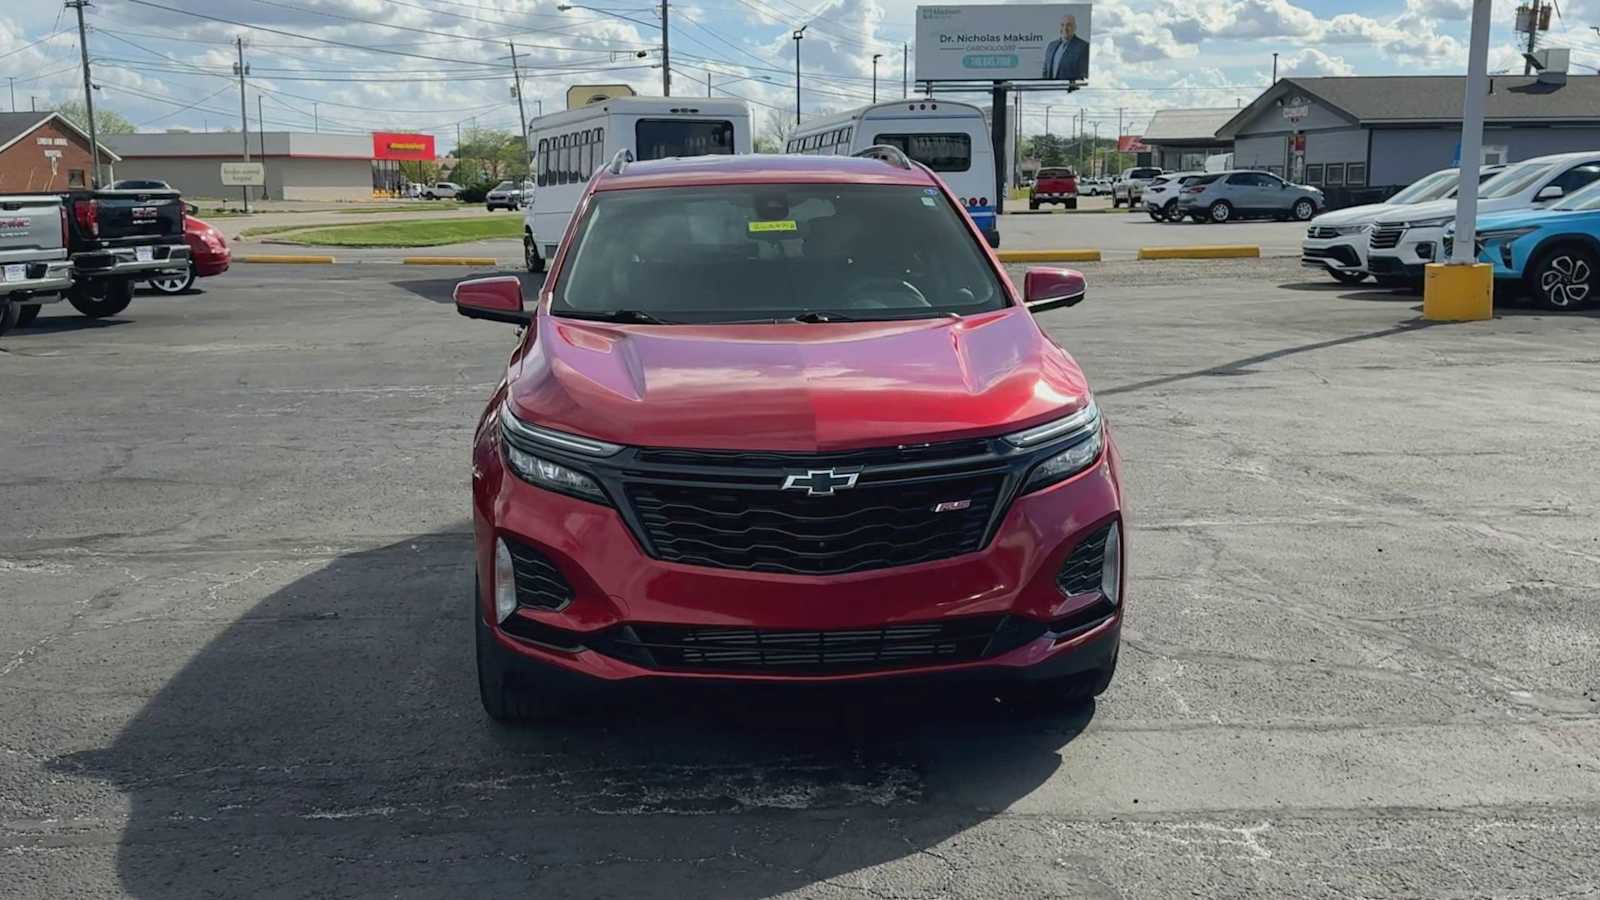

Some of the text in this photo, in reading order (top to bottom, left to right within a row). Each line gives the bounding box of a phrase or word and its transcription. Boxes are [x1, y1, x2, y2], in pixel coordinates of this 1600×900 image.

[940, 32, 1043, 43] Dr. Nicholas Maksim
[938, 500, 971, 511] RS
